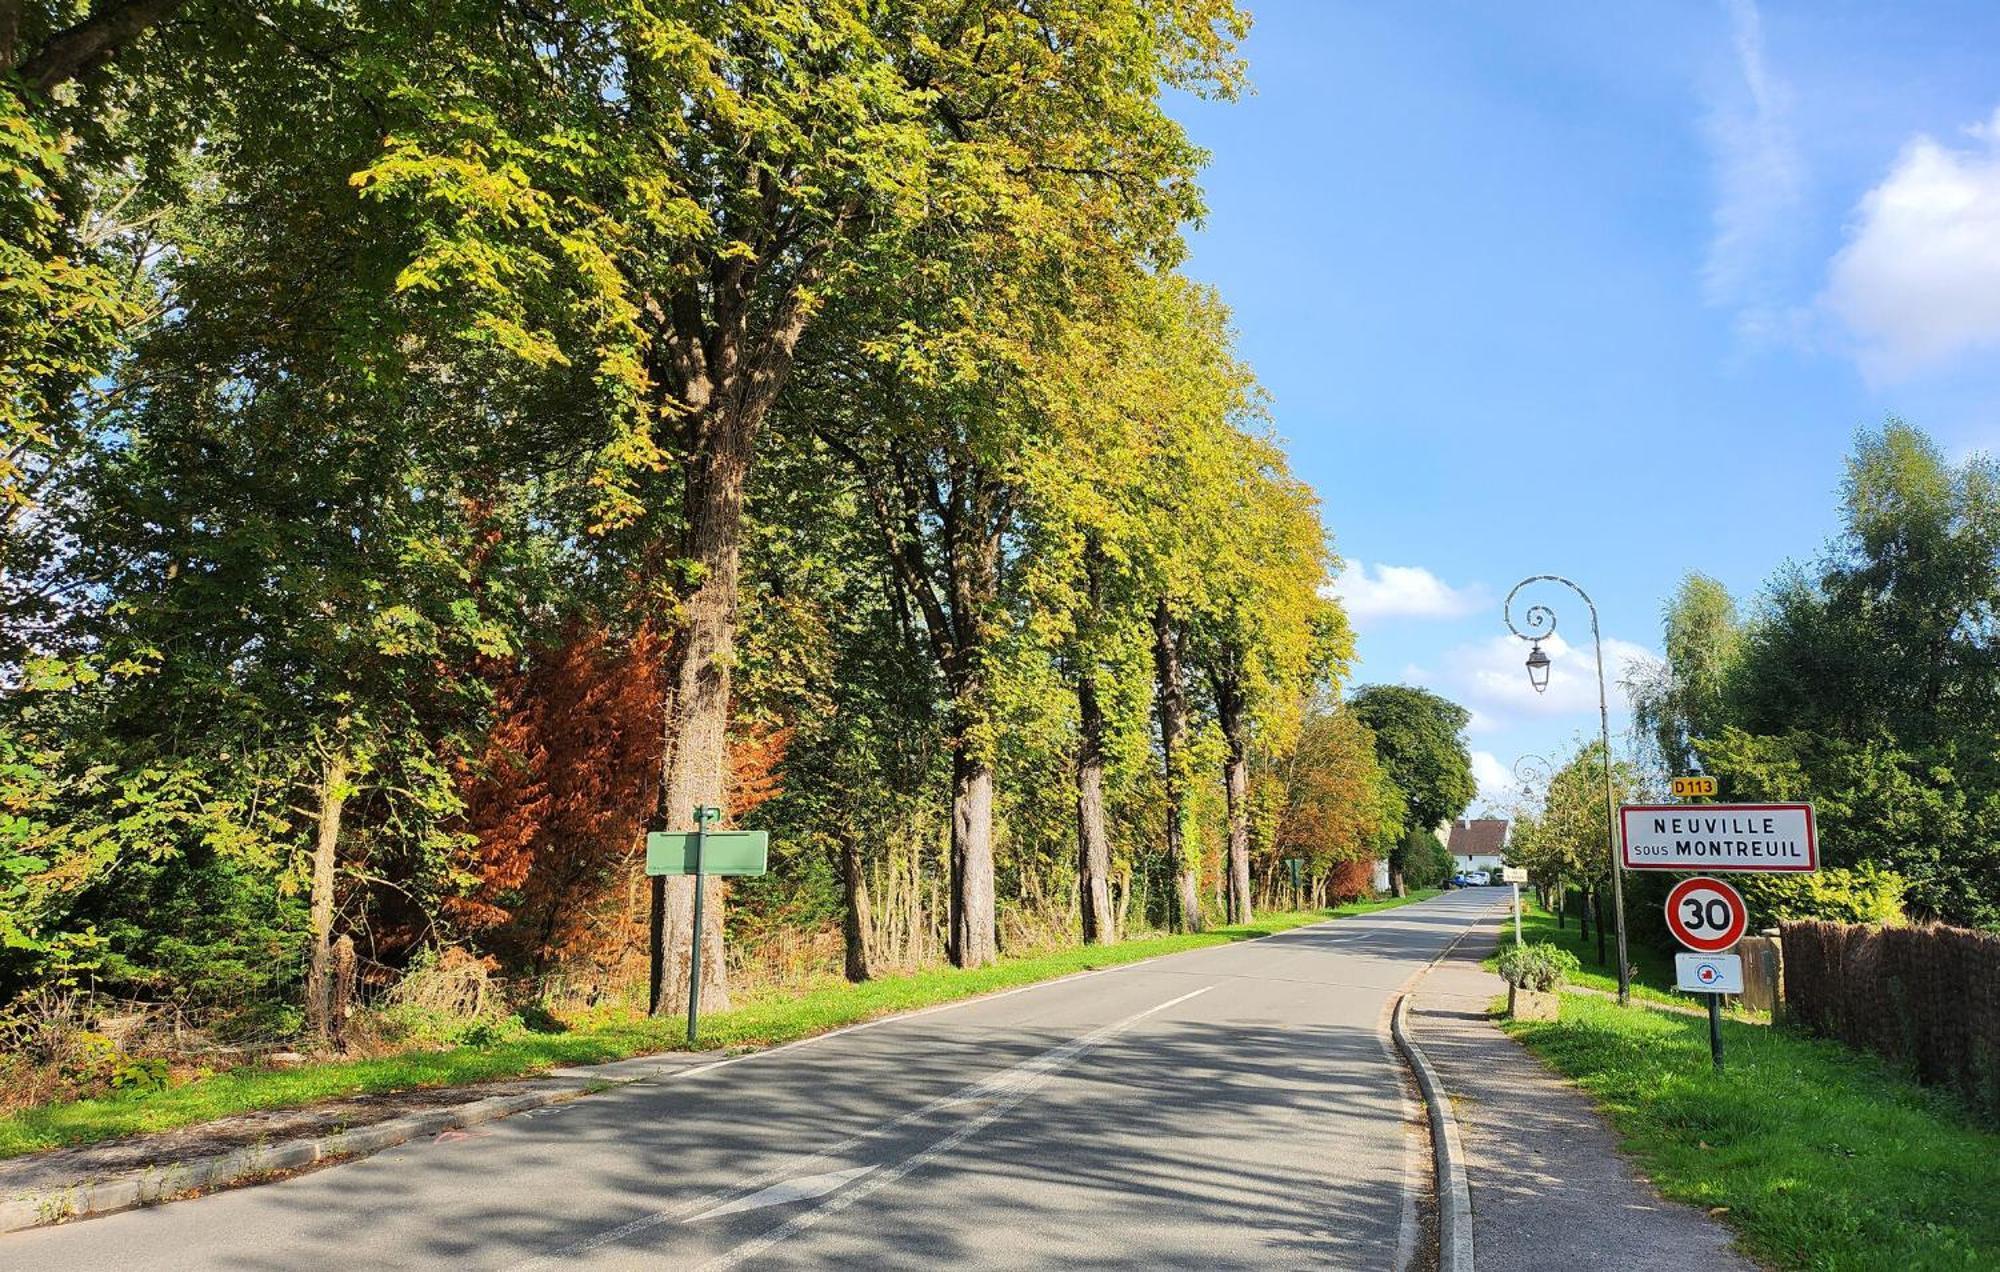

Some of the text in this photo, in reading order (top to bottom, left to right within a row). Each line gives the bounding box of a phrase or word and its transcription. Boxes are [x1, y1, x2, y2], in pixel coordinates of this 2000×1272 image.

[1654, 818, 1775, 834] NEUVILLE
[1676, 841, 1802, 857] MONTREUIL
[1682, 898, 1731, 931] 30
